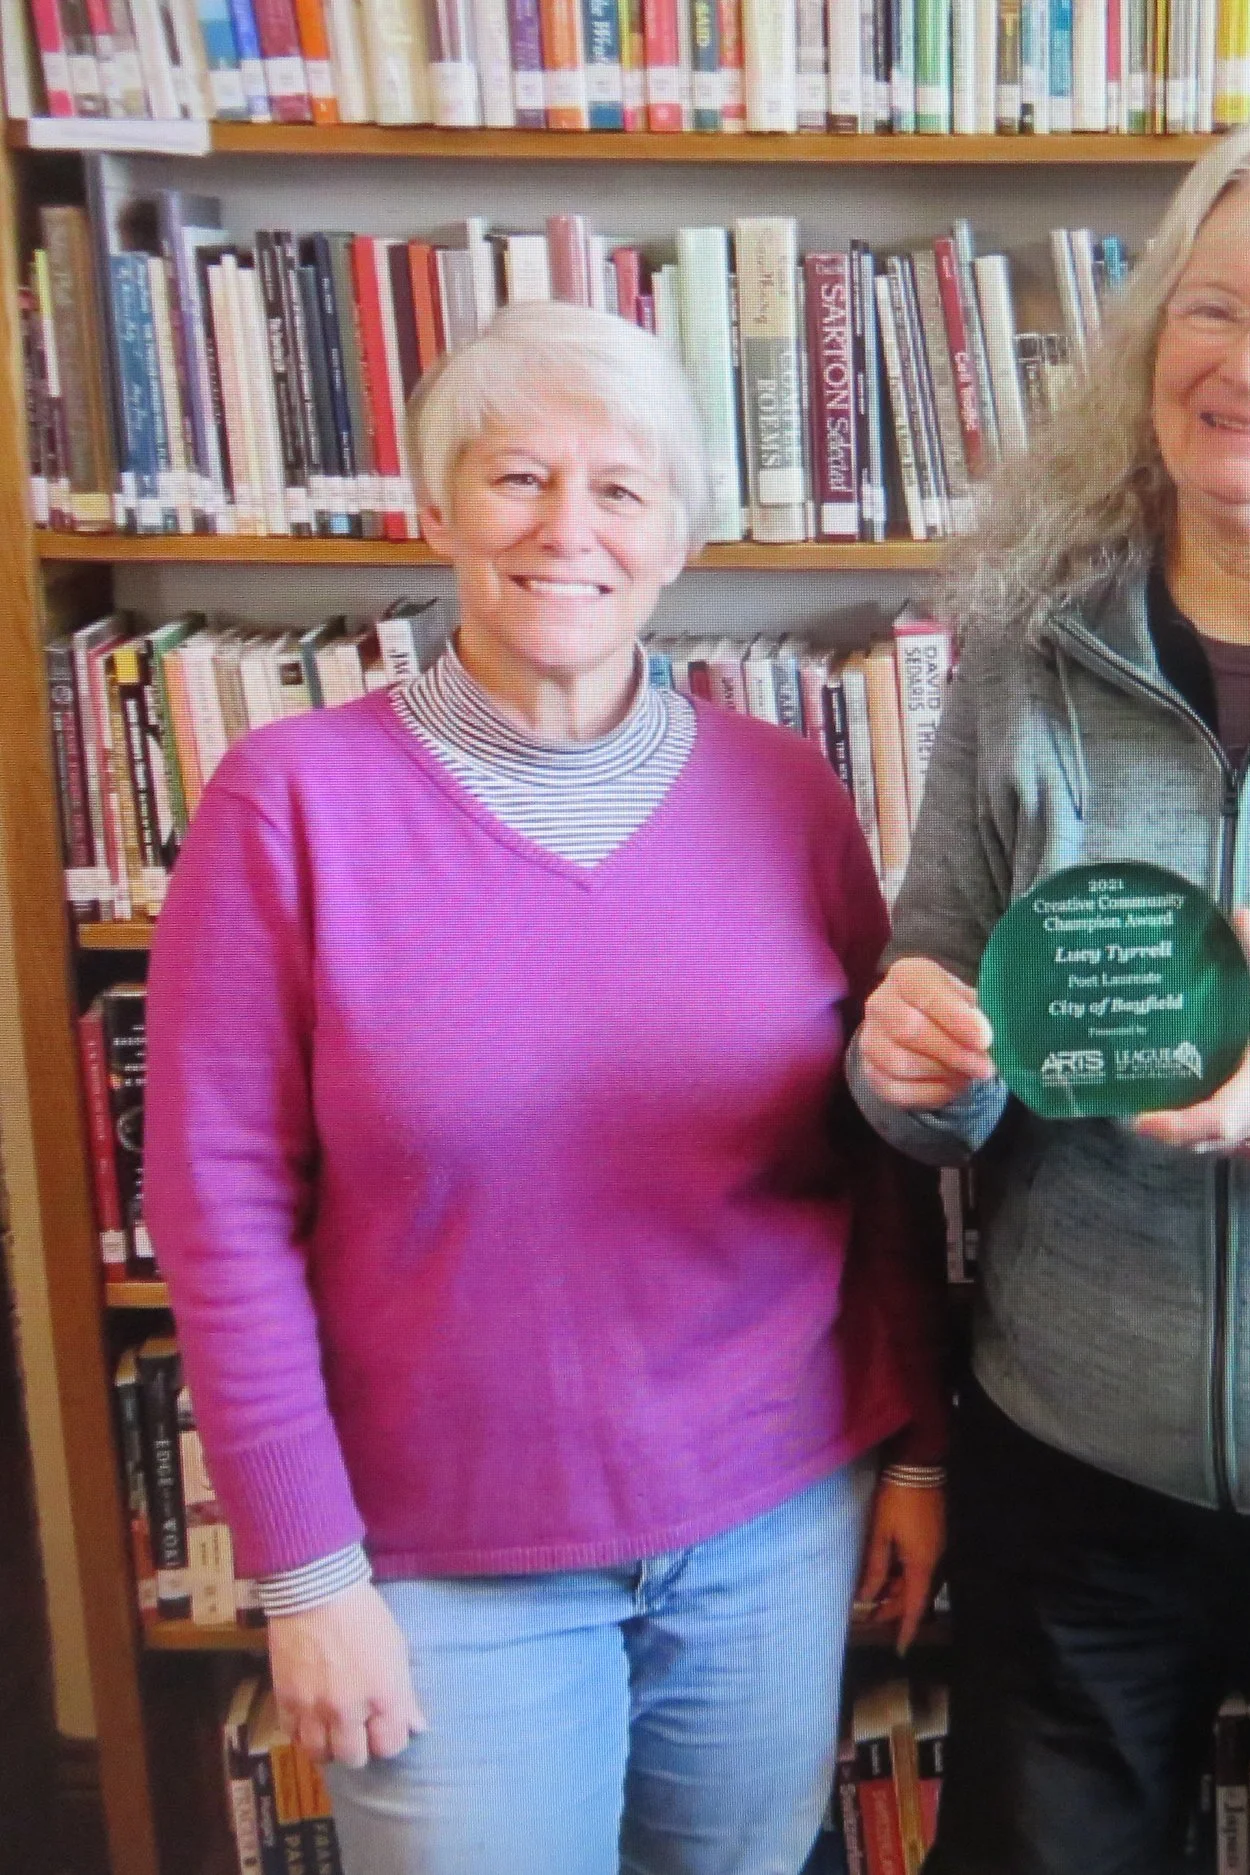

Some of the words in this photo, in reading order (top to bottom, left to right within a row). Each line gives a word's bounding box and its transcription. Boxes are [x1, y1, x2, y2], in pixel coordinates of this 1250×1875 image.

[820, 283, 852, 410] SARTON
[757, 379, 781, 467] POEMS
[905, 647, 926, 713] SEDARIS
[924, 645, 942, 711] DAVID
[1088, 878, 1124, 892] 2021
[1033, 897, 1096, 913] Creative
[1099, 893, 1184, 909] Community
[1043, 914, 1122, 933] Champion
[1124, 910, 1174, 927] Award
[1055, 947, 1100, 964] Lucy
[1105, 940, 1172, 963] Tyrrell
[1068, 974, 1099, 988] Poet
[1102, 971, 1162, 986] Laureate
[1049, 999, 1085, 1018] City
[1089, 996, 1111, 1017] of
[1111, 993, 1183, 1015] Bayfield
[154, 1438, 174, 1488] EDGE
